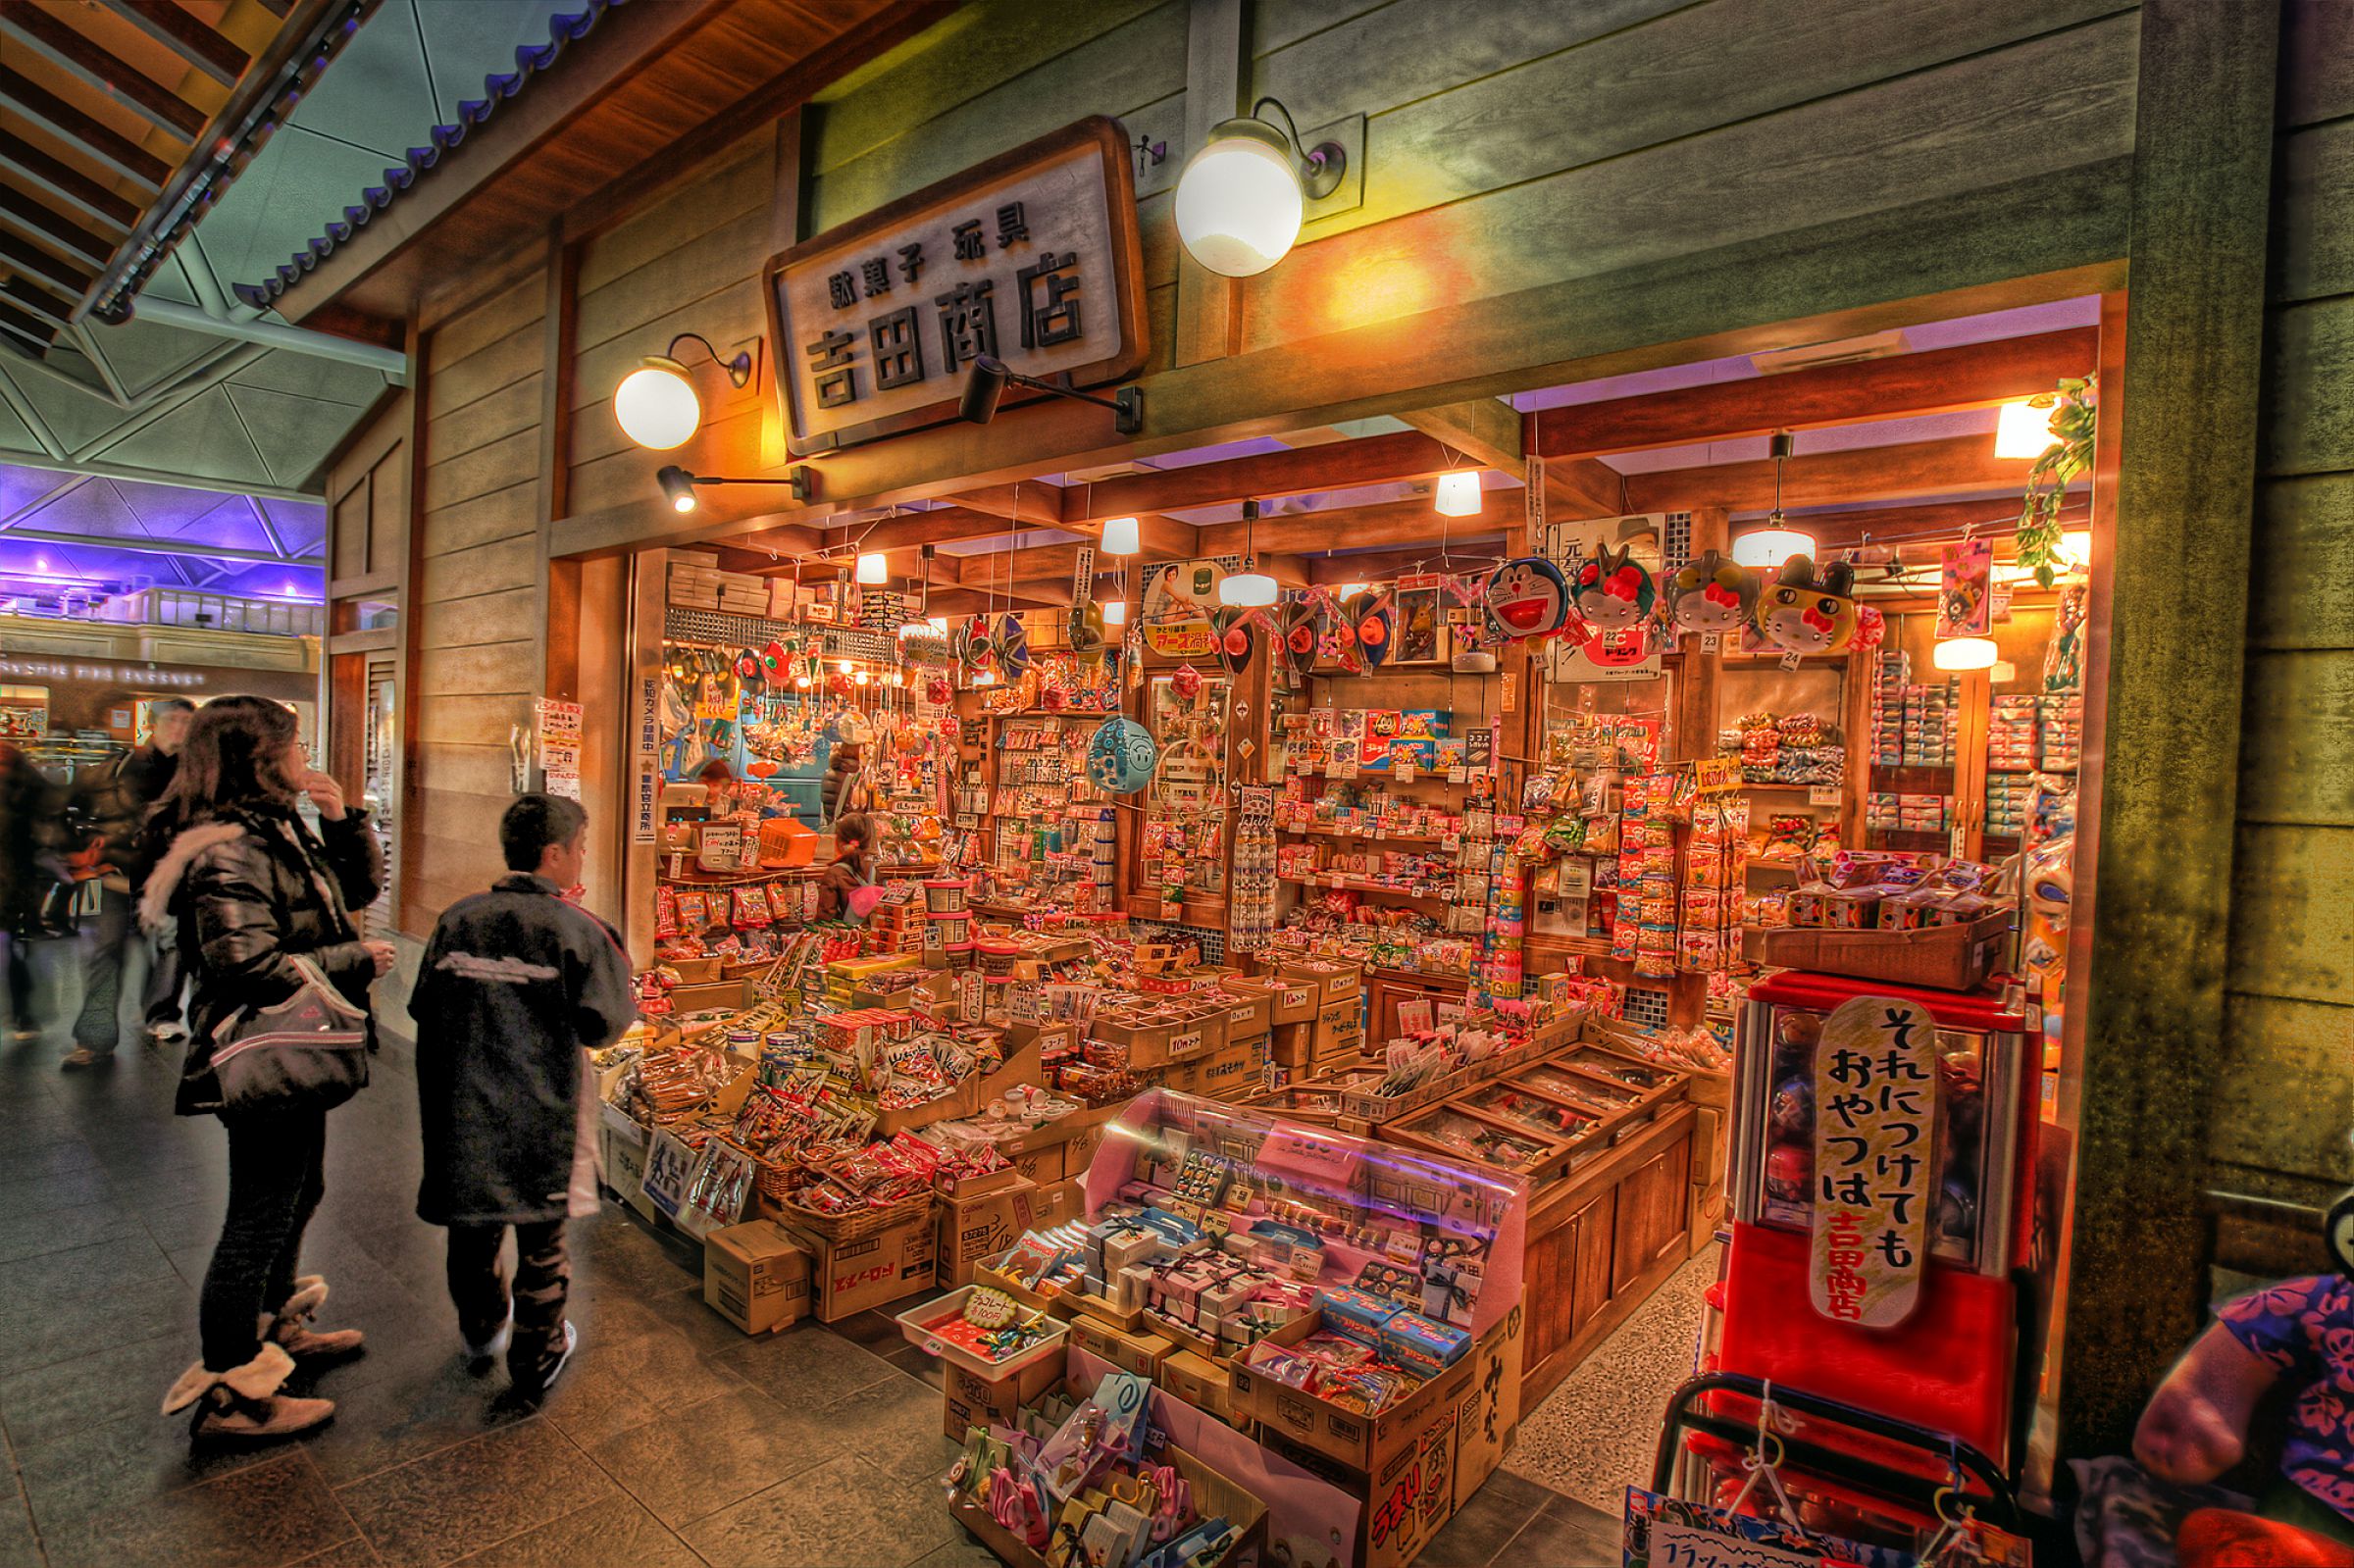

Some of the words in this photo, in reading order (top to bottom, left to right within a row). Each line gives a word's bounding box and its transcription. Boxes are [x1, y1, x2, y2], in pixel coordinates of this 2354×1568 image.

[827, 241, 926, 310] 駄菓子
[951, 200, 1030, 262] 玩具
[805, 250, 1084, 410] 吉田商店
[1606, 632, 1616, 640] 22
[1705, 635, 1716, 646] 23
[1785, 651, 1798, 663] 24
[642, 679, 656, 752] 防犯カメラ録画中
[640, 774, 654, 832] 警察官立寄所
[1875, 1007, 1930, 1268] それにつけても
[973, 1294, 1009, 1310] チョコレート
